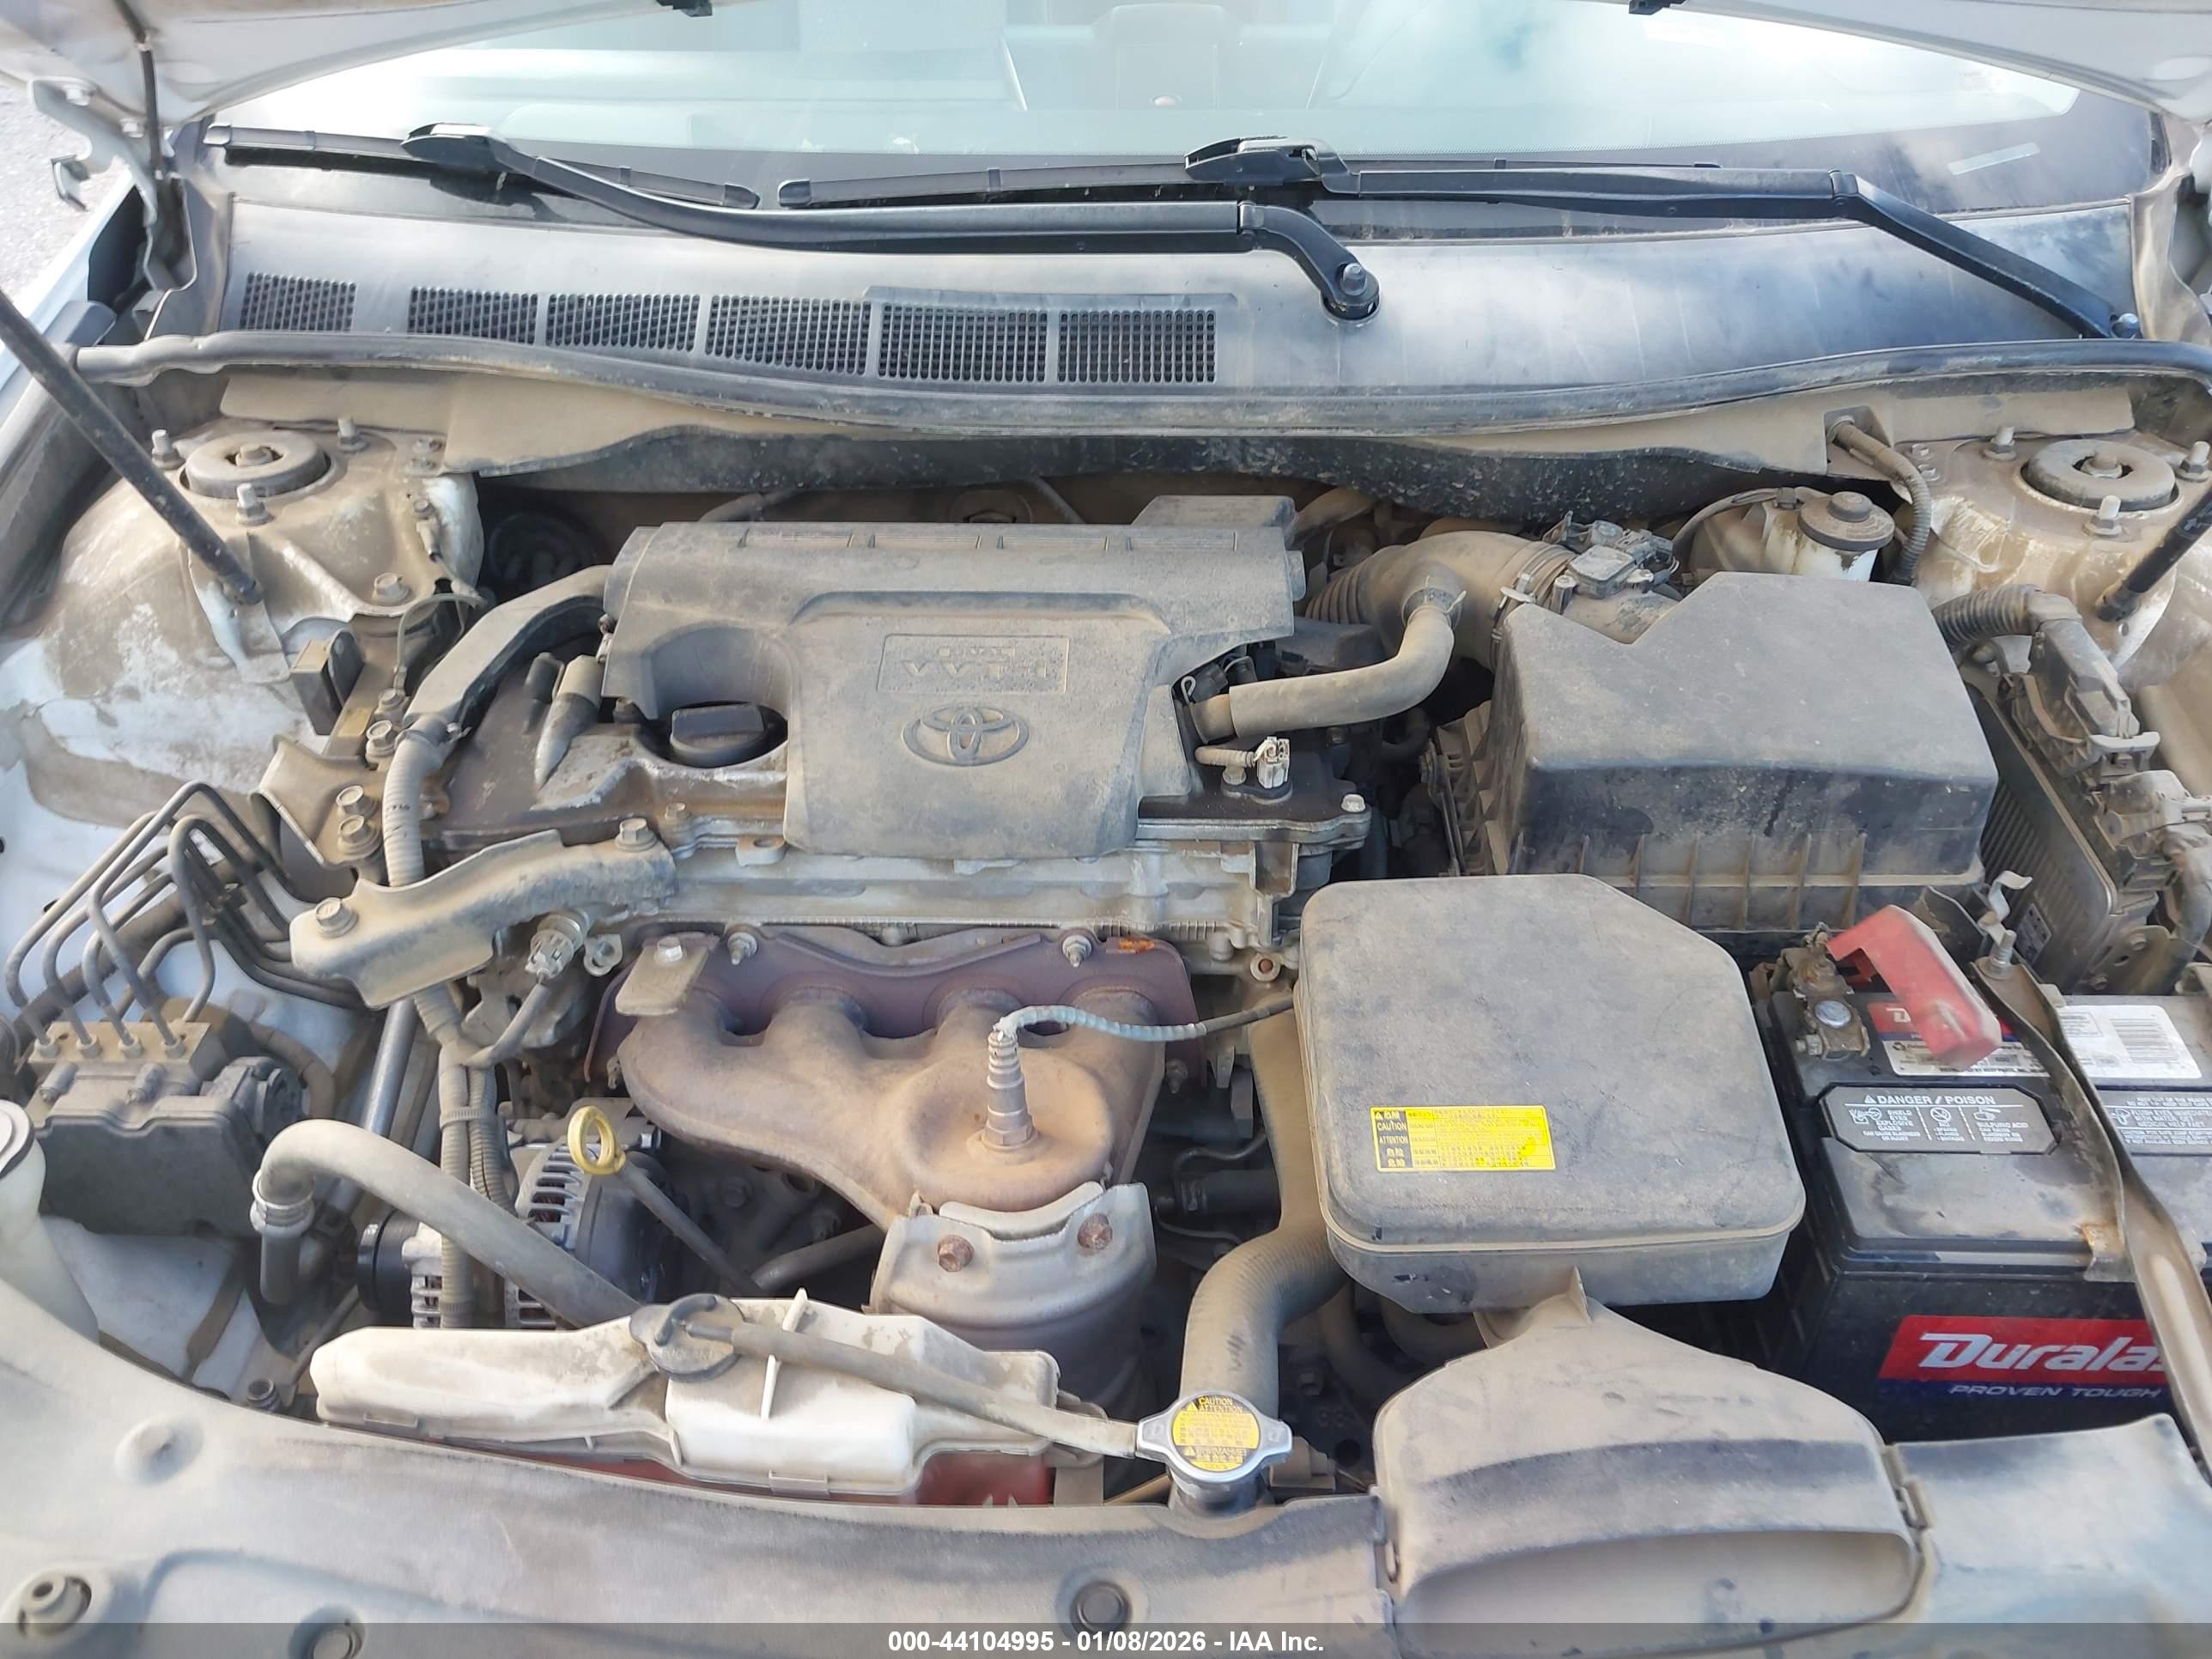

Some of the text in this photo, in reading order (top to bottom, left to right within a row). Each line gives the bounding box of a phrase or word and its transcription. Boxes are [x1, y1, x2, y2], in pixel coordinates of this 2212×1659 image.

[1876, 1095, 1933, 1104] DANGER
[1944, 1096, 1996, 1104] POISON
[1376, 1121, 1407, 1132] CAUTION
[1379, 1135, 1409, 1145] ATTENTION
[1948, 1384, 2162, 1399] PROVEN TOUGH
[1199, 1396, 1234, 1407] CAUTION
[1199, 1404, 1244, 1414] ATTENTION
